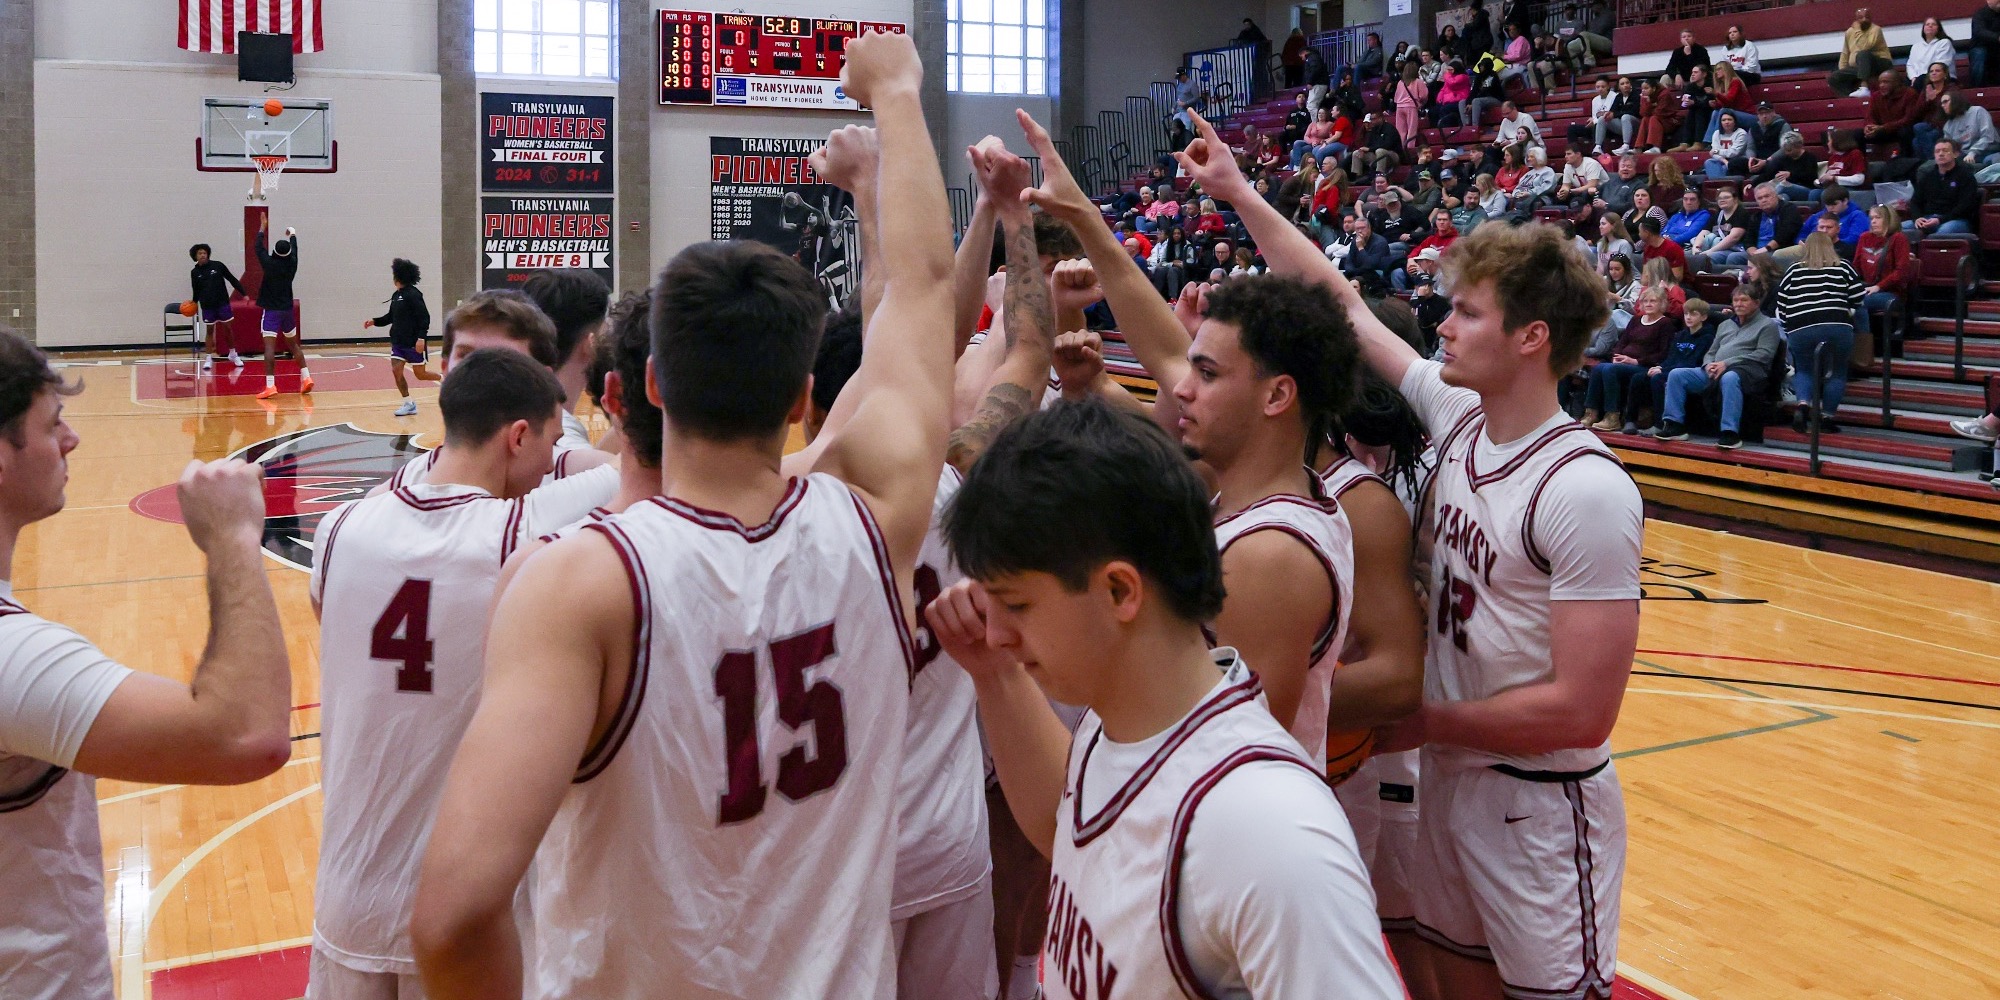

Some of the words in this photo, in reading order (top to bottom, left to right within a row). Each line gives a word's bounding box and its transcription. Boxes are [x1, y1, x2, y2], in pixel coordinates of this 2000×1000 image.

[722, 15, 754, 26] TRANSY
[765, 18, 799, 34] 52.8
[816, 20, 853, 31] BLUFFTON
[675, 24, 680, 34] 1
[682, 23, 691, 35] 0
[702, 24, 710, 36] 0
[672, 36, 680, 48] 3
[683, 36, 692, 48] 0
[702, 37, 710, 49] 0
[735, 30, 744, 46] 0
[671, 50, 680, 61] 5
[683, 50, 692, 62] 0
[702, 51, 710, 62] 0
[724, 55, 733, 67] 0
[750, 57, 758, 67] 4
[667, 62, 680, 75] 10
[683, 63, 692, 75] 0
[702, 64, 711, 76] 0
[817, 60, 825, 70] 4
[664, 75, 680, 87] 23
[683, 76, 692, 88] 0
[702, 77, 710, 89] 0
[750, 82, 823, 95] TRANSYLVANIA
[511, 102, 585, 115] TRANSYLVANIA
[488, 114, 607, 139] PIONEERS
[503, 139, 543, 149] WOMEN'S
[543, 140, 594, 150] BASKETBALL
[510, 151, 548, 161] FINAL
[552, 151, 587, 162] FOUR
[495, 167, 533, 181] 2024
[566, 168, 600, 182] 31-1
[711, 154, 832, 185] PIONEE
[712, 185, 737, 194] MEN'S
[737, 186, 785, 195] BASKETBALL
[510, 199, 590, 211] TRANSYLVANIA
[485, 213, 611, 238] PIONEERS
[485, 239, 528, 252] MEN'S
[530, 239, 610, 252] BASKETBALL
[515, 254, 565, 267] ELITE
[569, 254, 581, 267] 8
[1434, 503, 1498, 588] TANSY
[1437, 564, 1477, 656] 12
[369, 575, 436, 696] 4
[711, 622, 849, 828] 15
[1046, 873, 1119, 1000] RANSY
